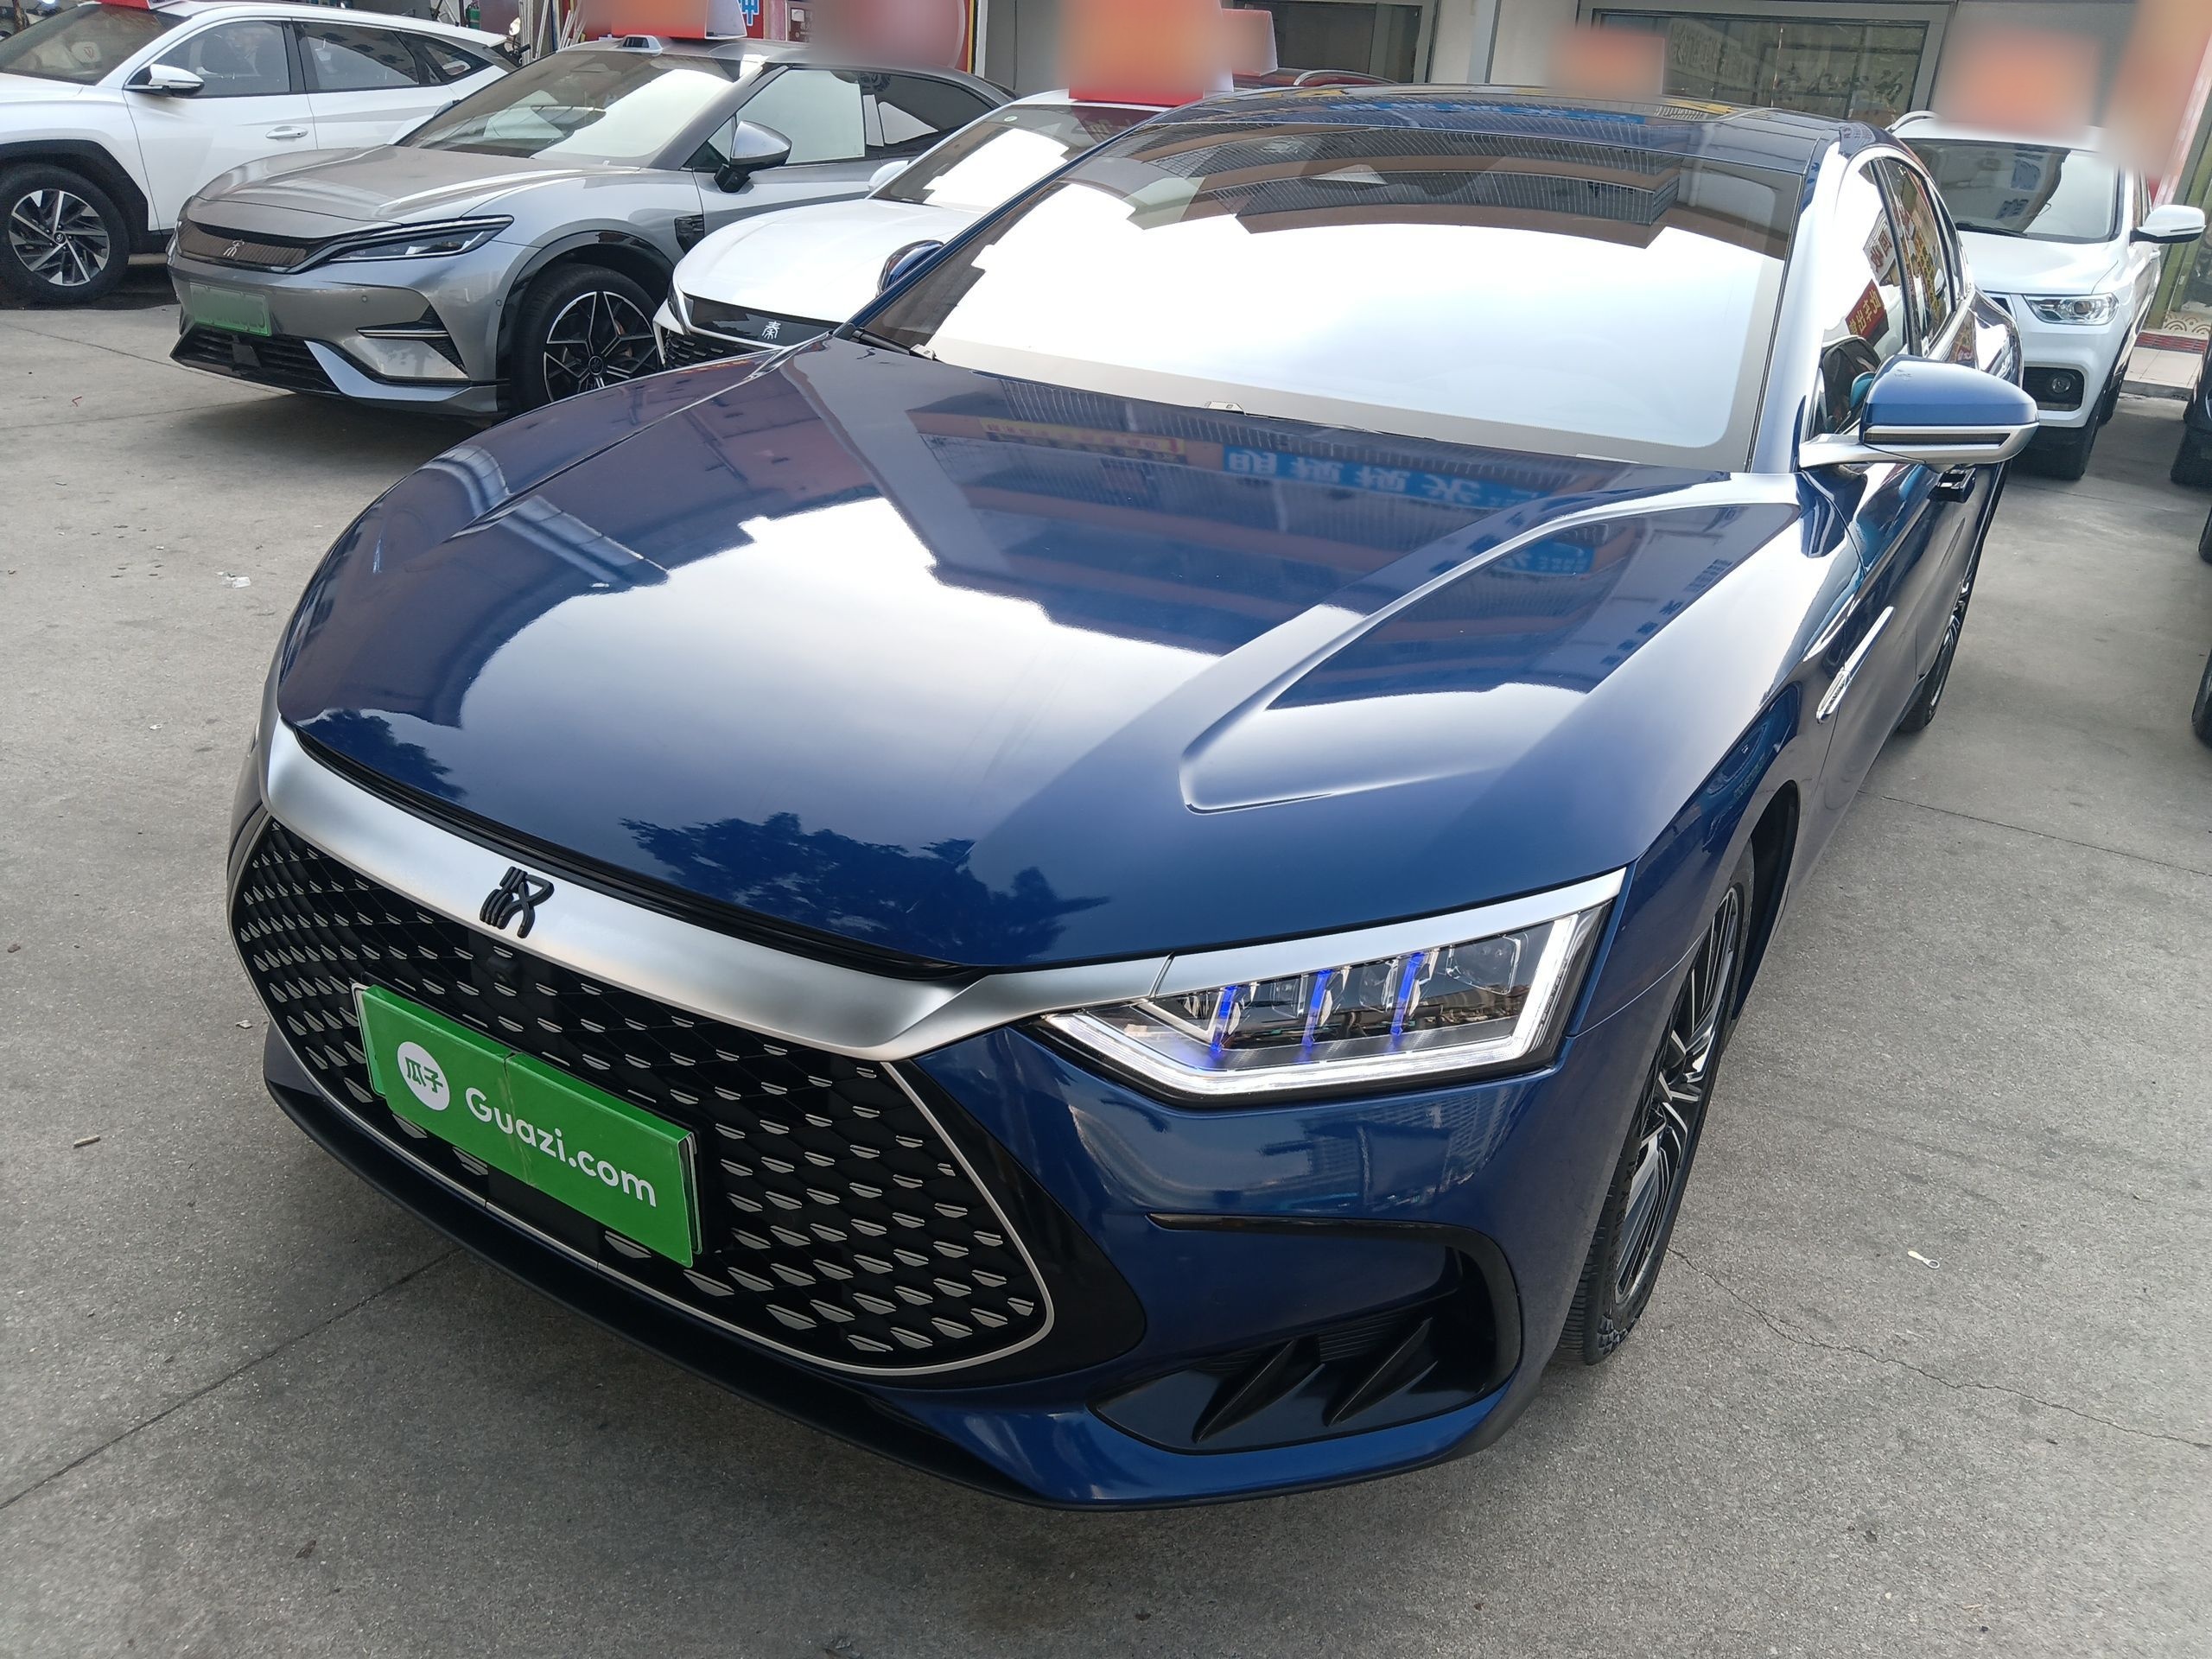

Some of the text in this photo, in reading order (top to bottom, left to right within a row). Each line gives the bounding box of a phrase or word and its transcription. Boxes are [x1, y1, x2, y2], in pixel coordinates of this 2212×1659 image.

[761, 321, 782, 340] 秦
[404, 1057, 443, 1093] 瓜子
[465, 1087, 657, 1208] Guazi.com
